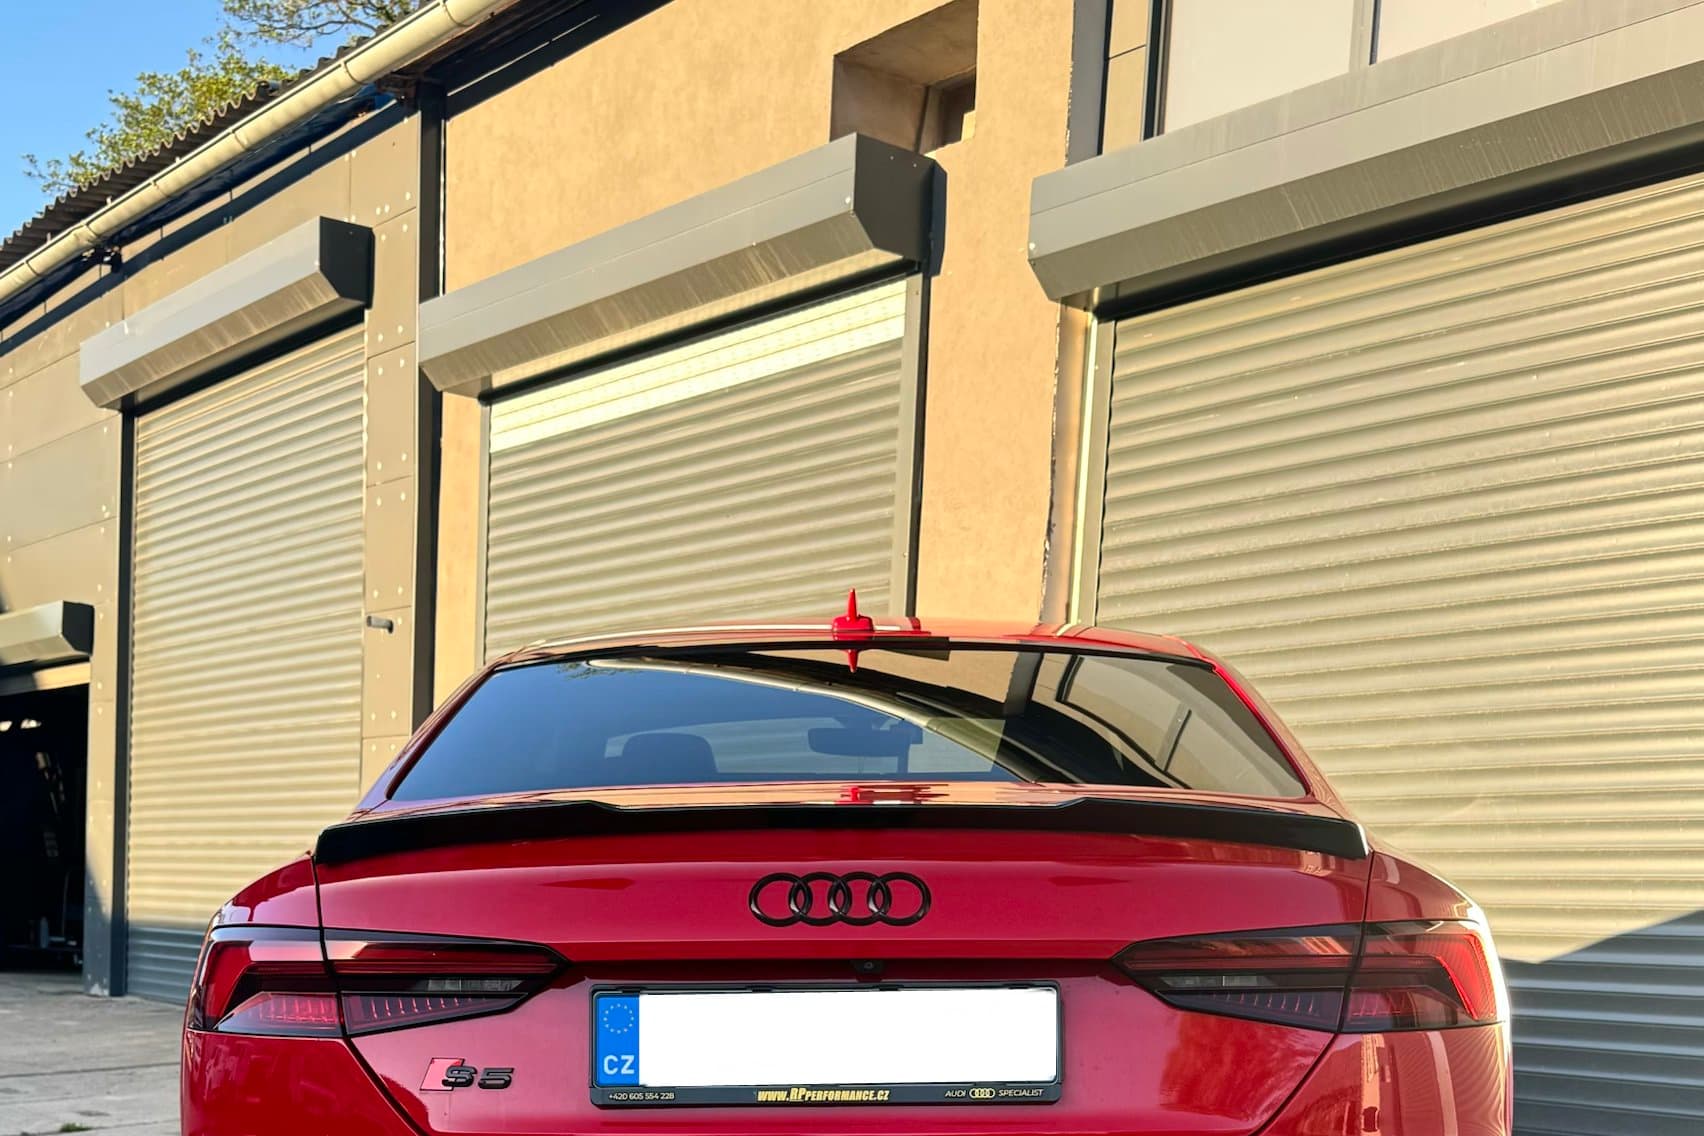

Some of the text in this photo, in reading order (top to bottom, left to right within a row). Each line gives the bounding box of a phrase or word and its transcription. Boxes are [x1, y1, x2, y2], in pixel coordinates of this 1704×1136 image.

[603, 1054, 635, 1075] CZ
[441, 1065, 514, 1090] S5
[608, 1092, 675, 1100] +420 605 554 228
[944, 1088, 1044, 1098] AUDI SPECIALIST
